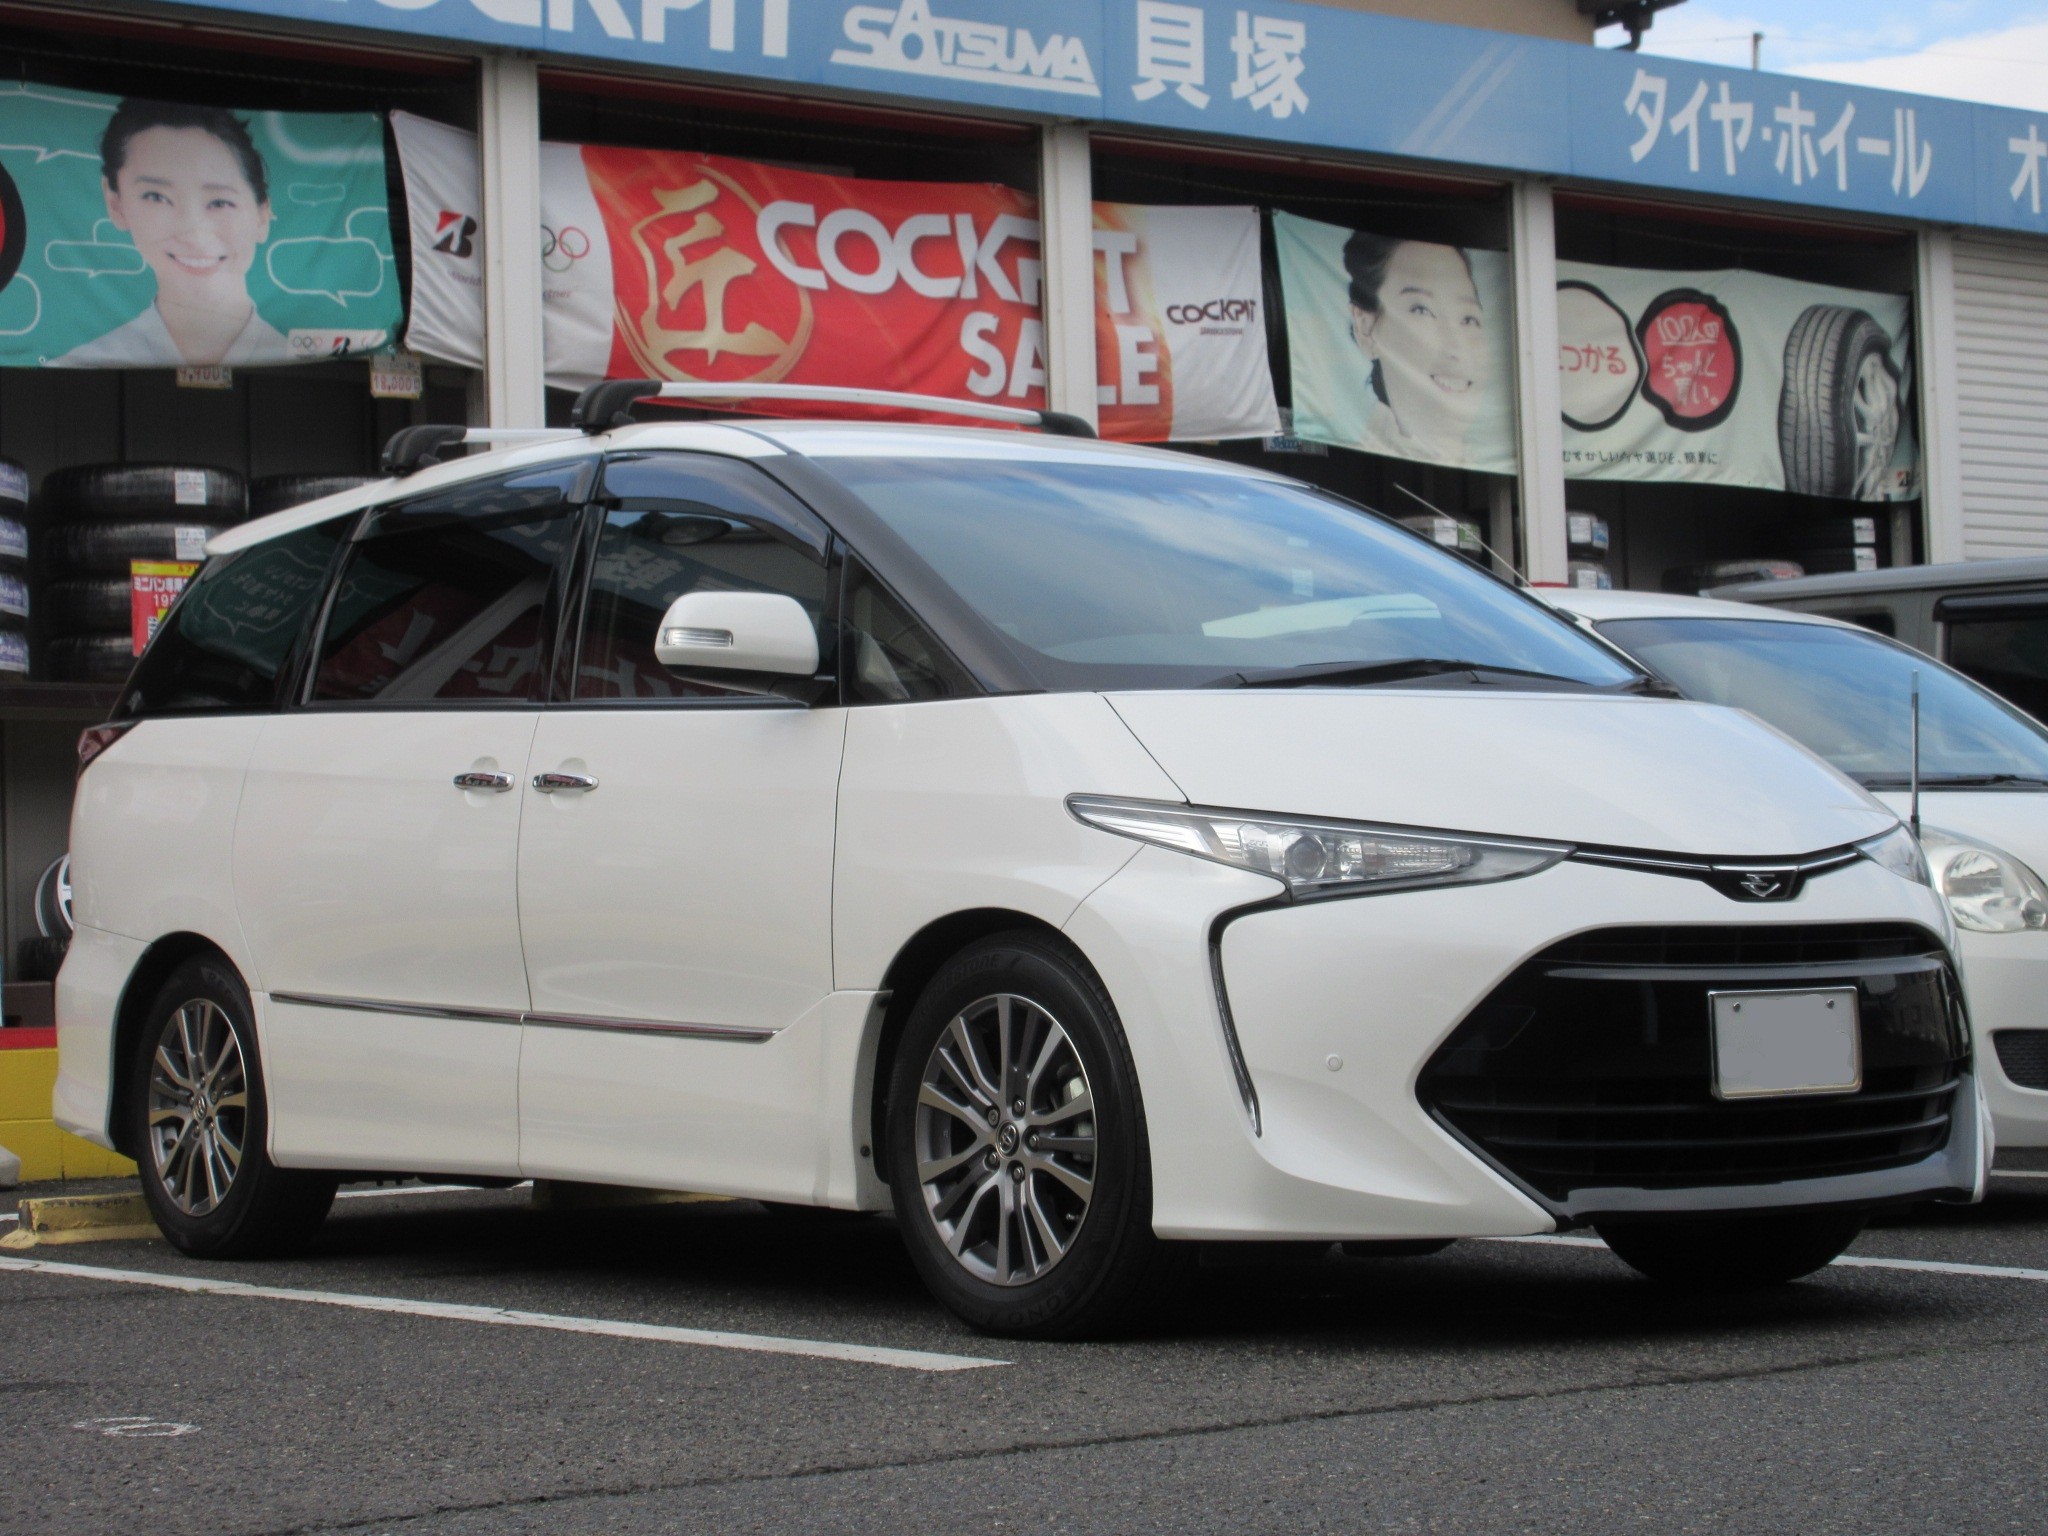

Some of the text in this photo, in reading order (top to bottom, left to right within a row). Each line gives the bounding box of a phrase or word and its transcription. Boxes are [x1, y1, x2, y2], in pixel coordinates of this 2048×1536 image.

[829, 0, 1101, 97] SATSUMA
[1131, 0, 1309, 118] 貝塚
[1624, 68, 1932, 198] タイヤ・ホイール
[755, 199, 1137, 313] COCKT
[959, 311, 1160, 405] SAE
[1558, 344, 1627, 374] つかる
